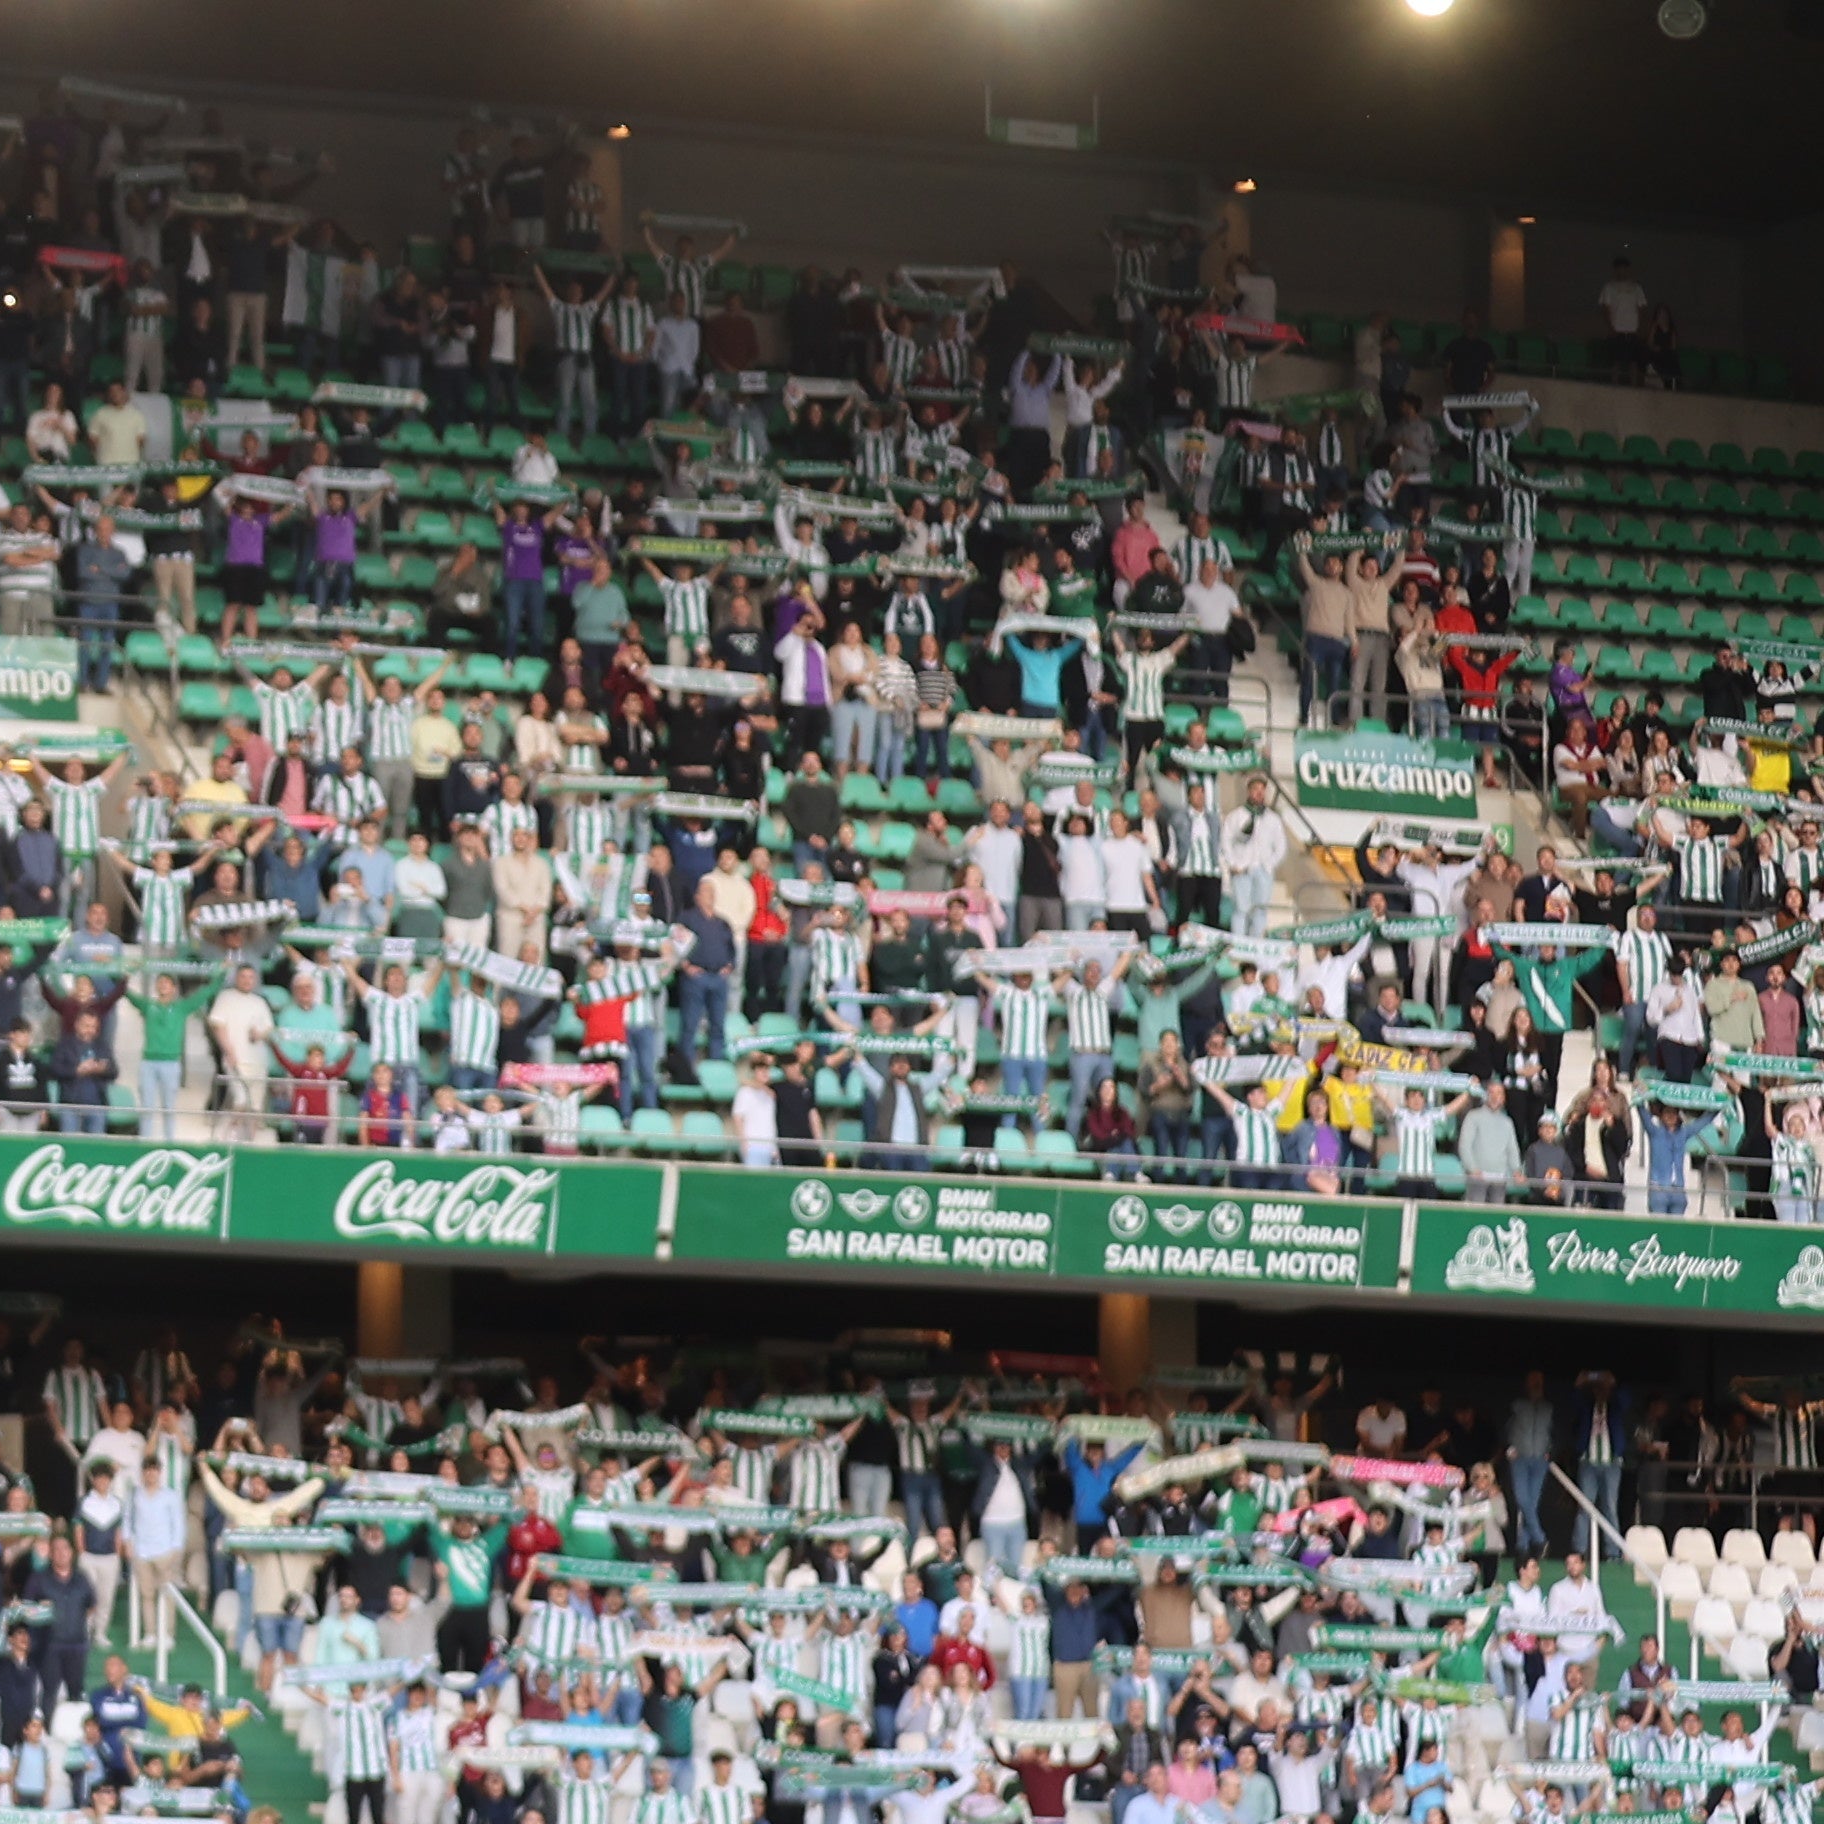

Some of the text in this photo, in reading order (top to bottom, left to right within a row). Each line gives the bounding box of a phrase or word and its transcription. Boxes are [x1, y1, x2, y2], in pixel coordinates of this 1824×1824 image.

[1298, 749, 1473, 801] Cruzcampo
[3, 1143, 230, 1230] Coca-Cola
[333, 1160, 557, 1246] Coca-Cola
[937, 1187, 992, 1210] BMW
[936, 1209, 1051, 1236] MOTORRAD
[1252, 1201, 1303, 1225] BMW
[786, 1227, 1048, 1269] SAN RAFAEL MOTOR
[1250, 1224, 1360, 1249] MOTORRAD
[1104, 1243, 1358, 1282] SAN RAFAEL MOTOR
